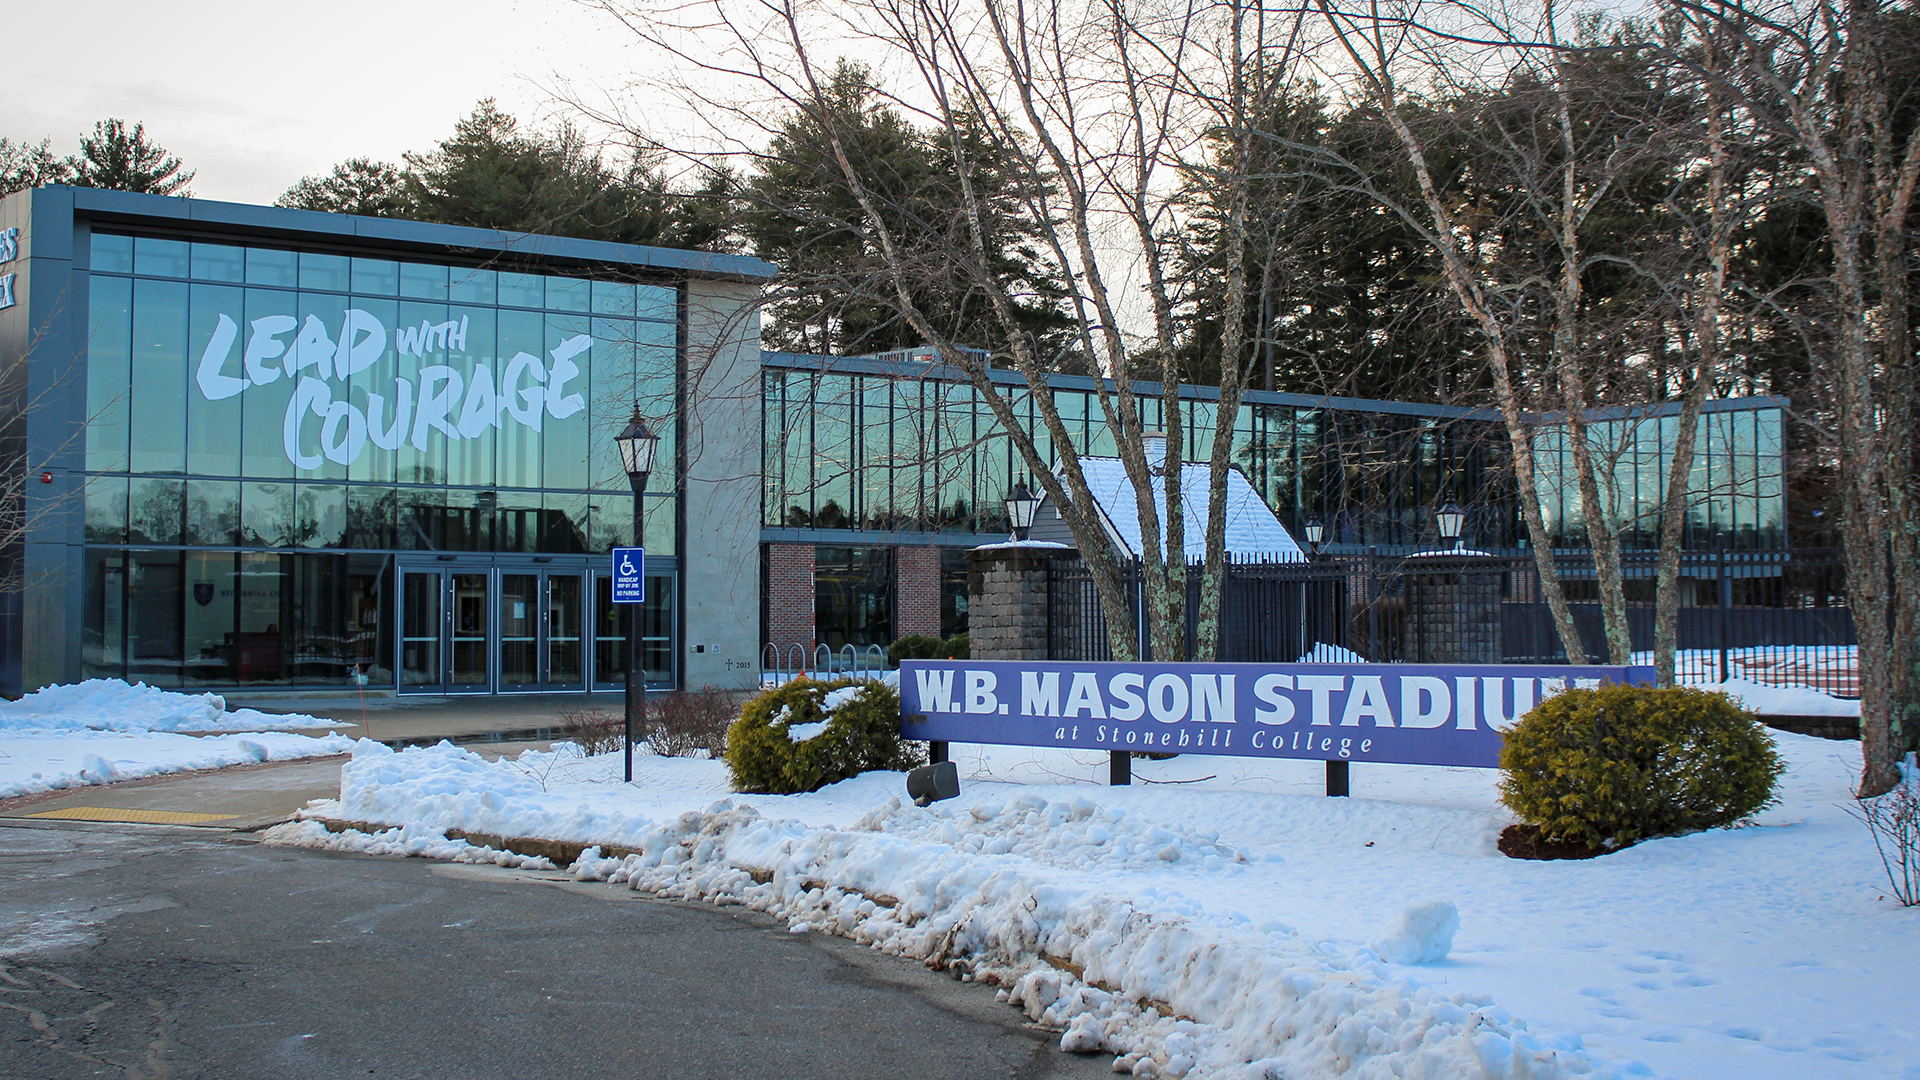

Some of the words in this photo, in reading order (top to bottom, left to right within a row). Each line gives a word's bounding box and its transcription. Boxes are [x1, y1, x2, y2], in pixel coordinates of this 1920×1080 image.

[196, 309, 387, 400] LEAD
[396, 314, 468, 357] WITH
[283, 334, 593, 470] COURAGE
[914, 669, 1009, 715] W.B.
[1020, 671, 1237, 723] MASON
[1253, 673, 1601, 733] STADIU
[1054, 725, 1079, 741] at
[1096, 724, 1232, 748] Stonehill
[1251, 730, 1372, 757] College
